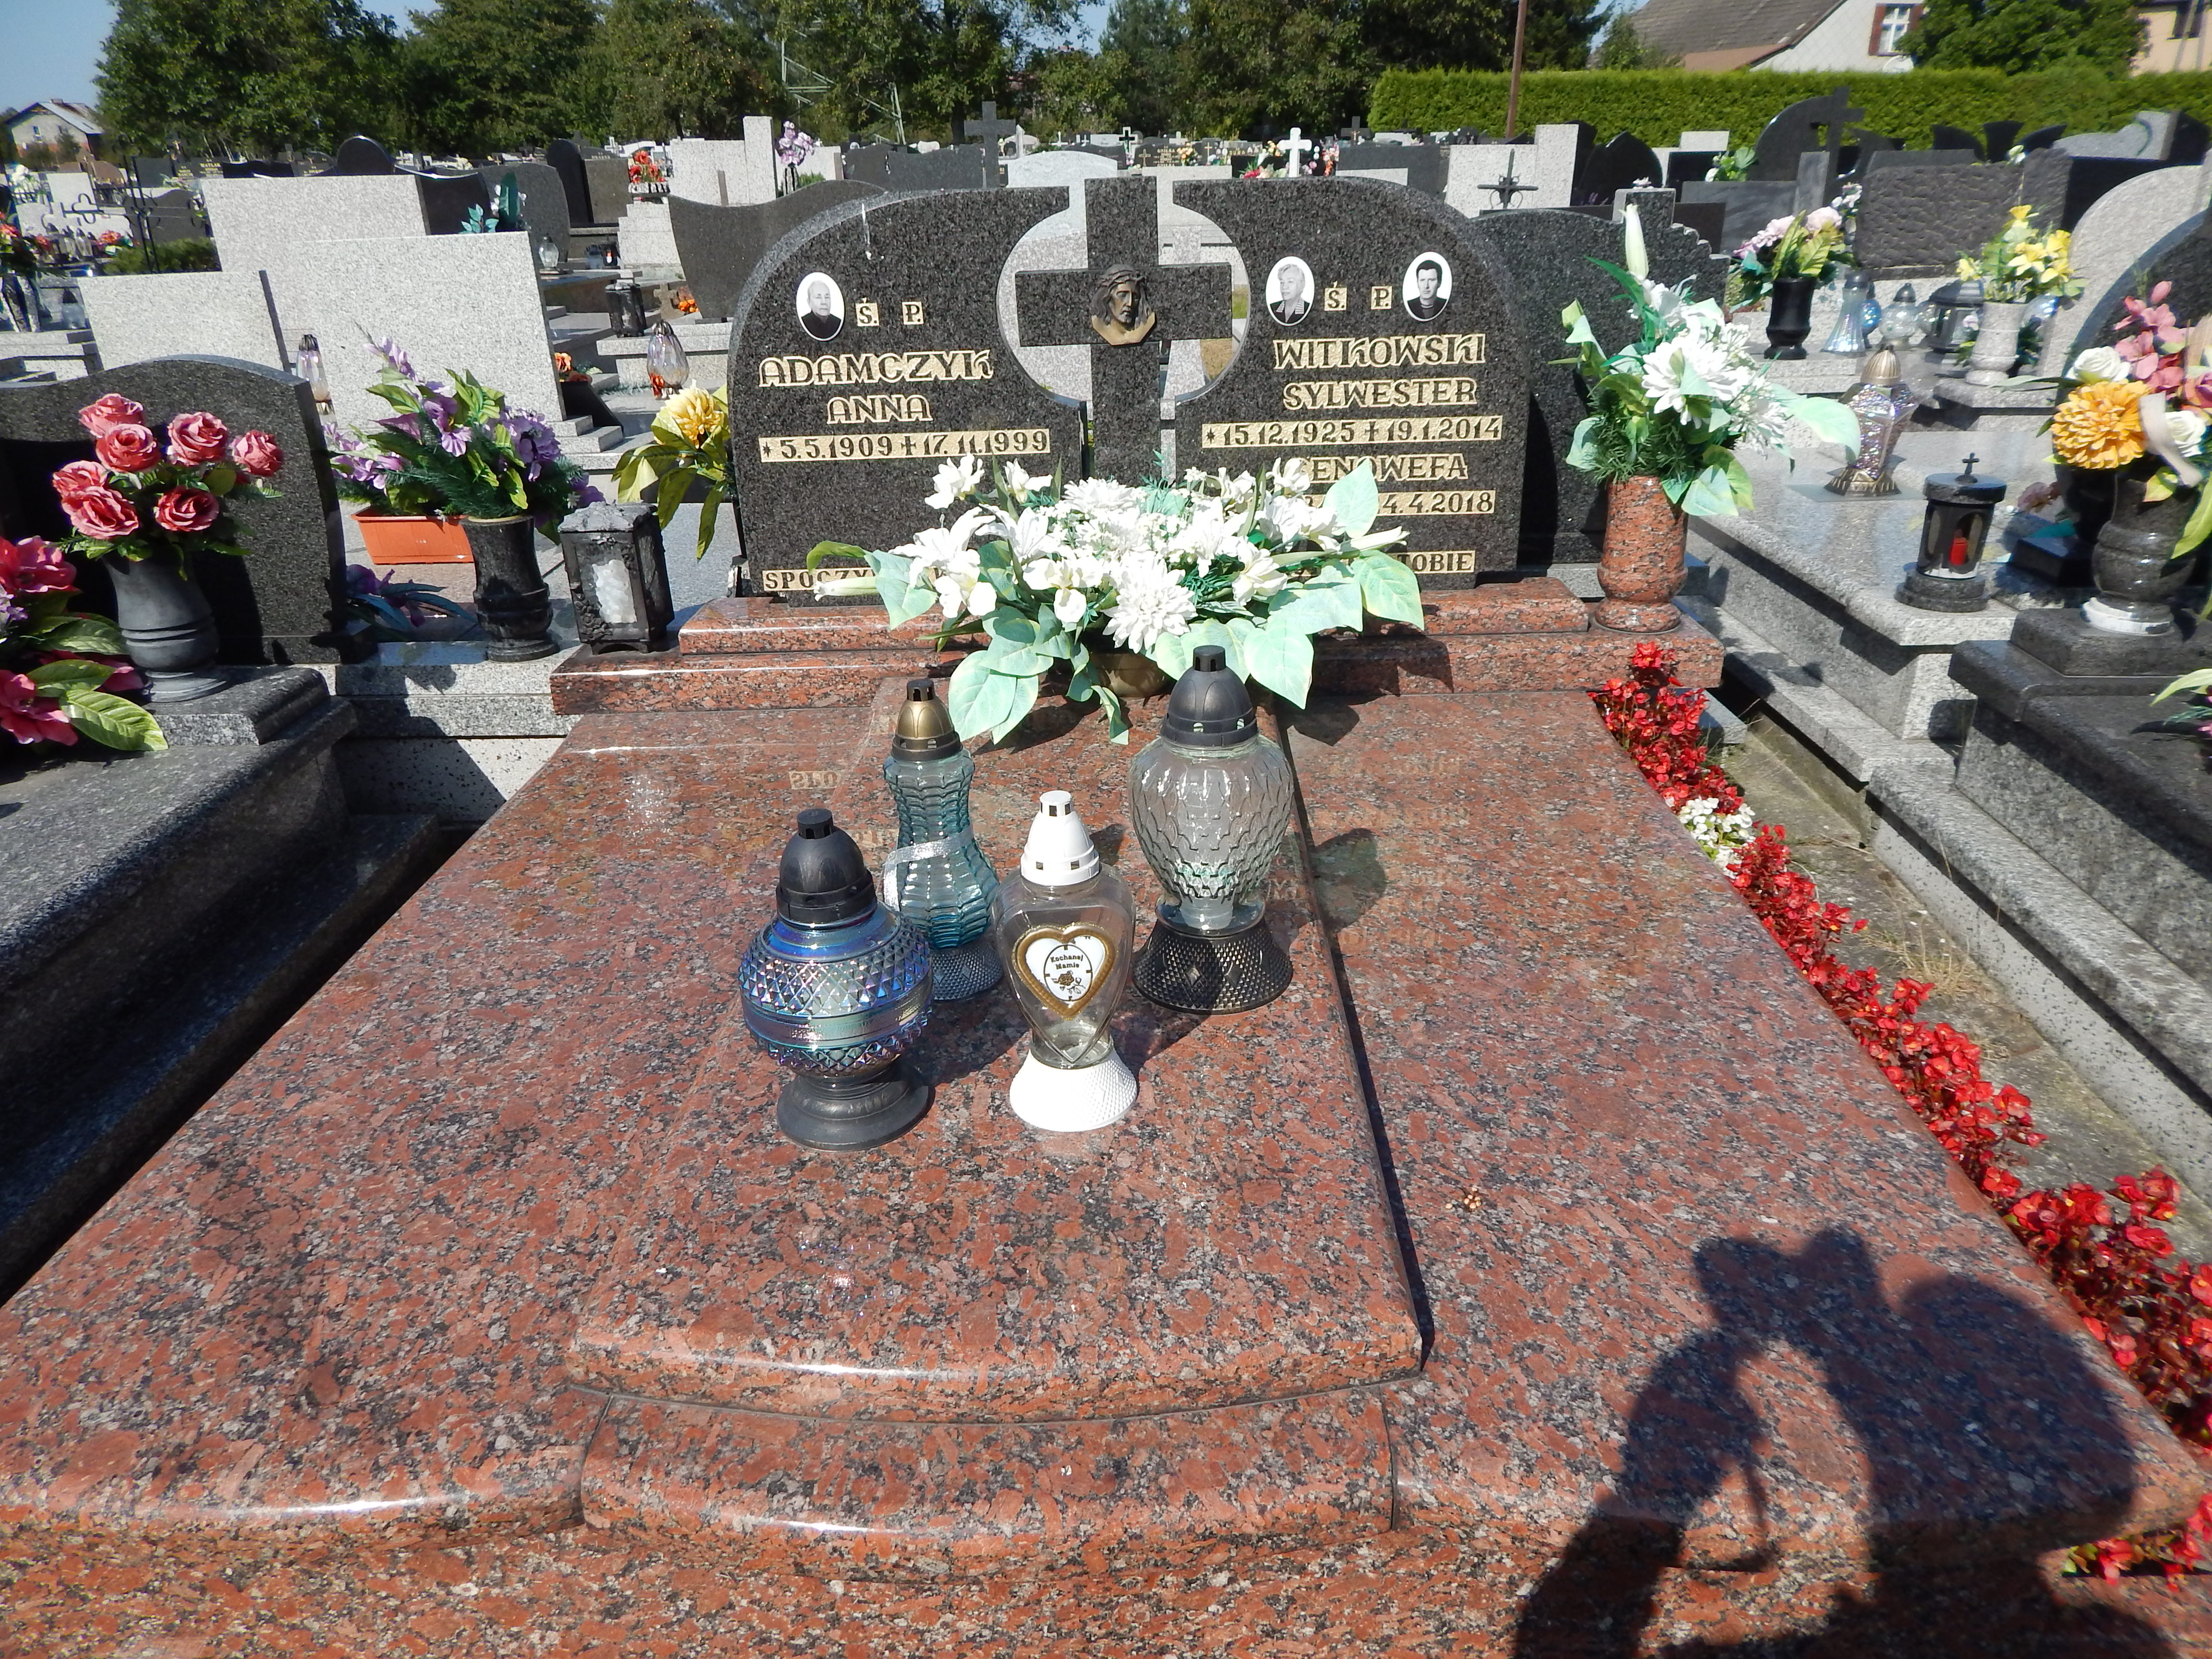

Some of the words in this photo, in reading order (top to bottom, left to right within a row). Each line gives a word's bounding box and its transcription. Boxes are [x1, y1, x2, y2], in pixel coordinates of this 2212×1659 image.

[903, 303, 921, 323] P.
[1373, 288, 1390, 308] P.
[1273, 334, 1486, 370] WITKOWSKI
[759, 349, 994, 387] ADAMCZYK
[1283, 377, 1477, 410] SYLWESTER
[827, 394, 933, 424] ANNA
[1299, 453, 1468, 484] ENOWEFA
[1377, 491, 1494, 514] 4.4.2018
